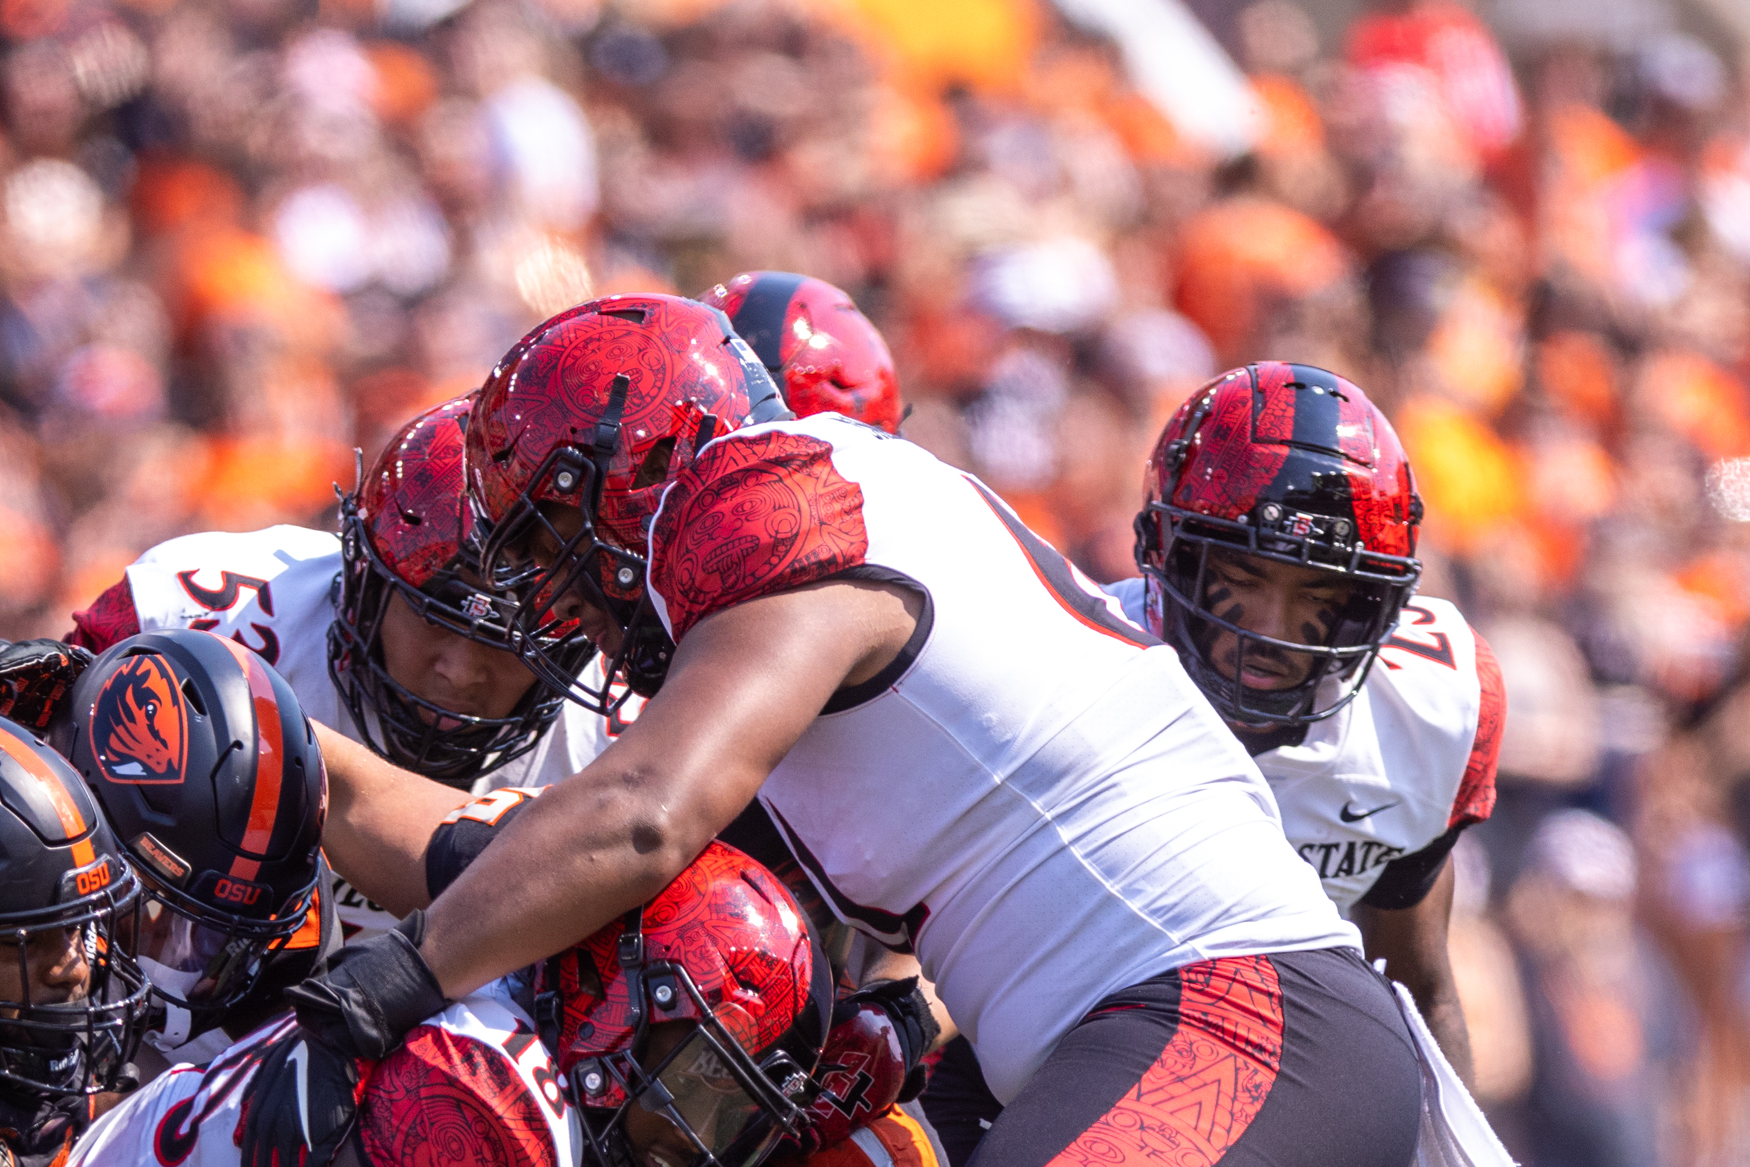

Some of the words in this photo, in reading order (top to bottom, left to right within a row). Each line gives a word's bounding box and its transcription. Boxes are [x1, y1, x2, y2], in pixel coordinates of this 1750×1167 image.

[139, 835, 185, 878] BEAVERS
[76, 862, 111, 895] OSU
[213, 878, 262, 905] OSU
